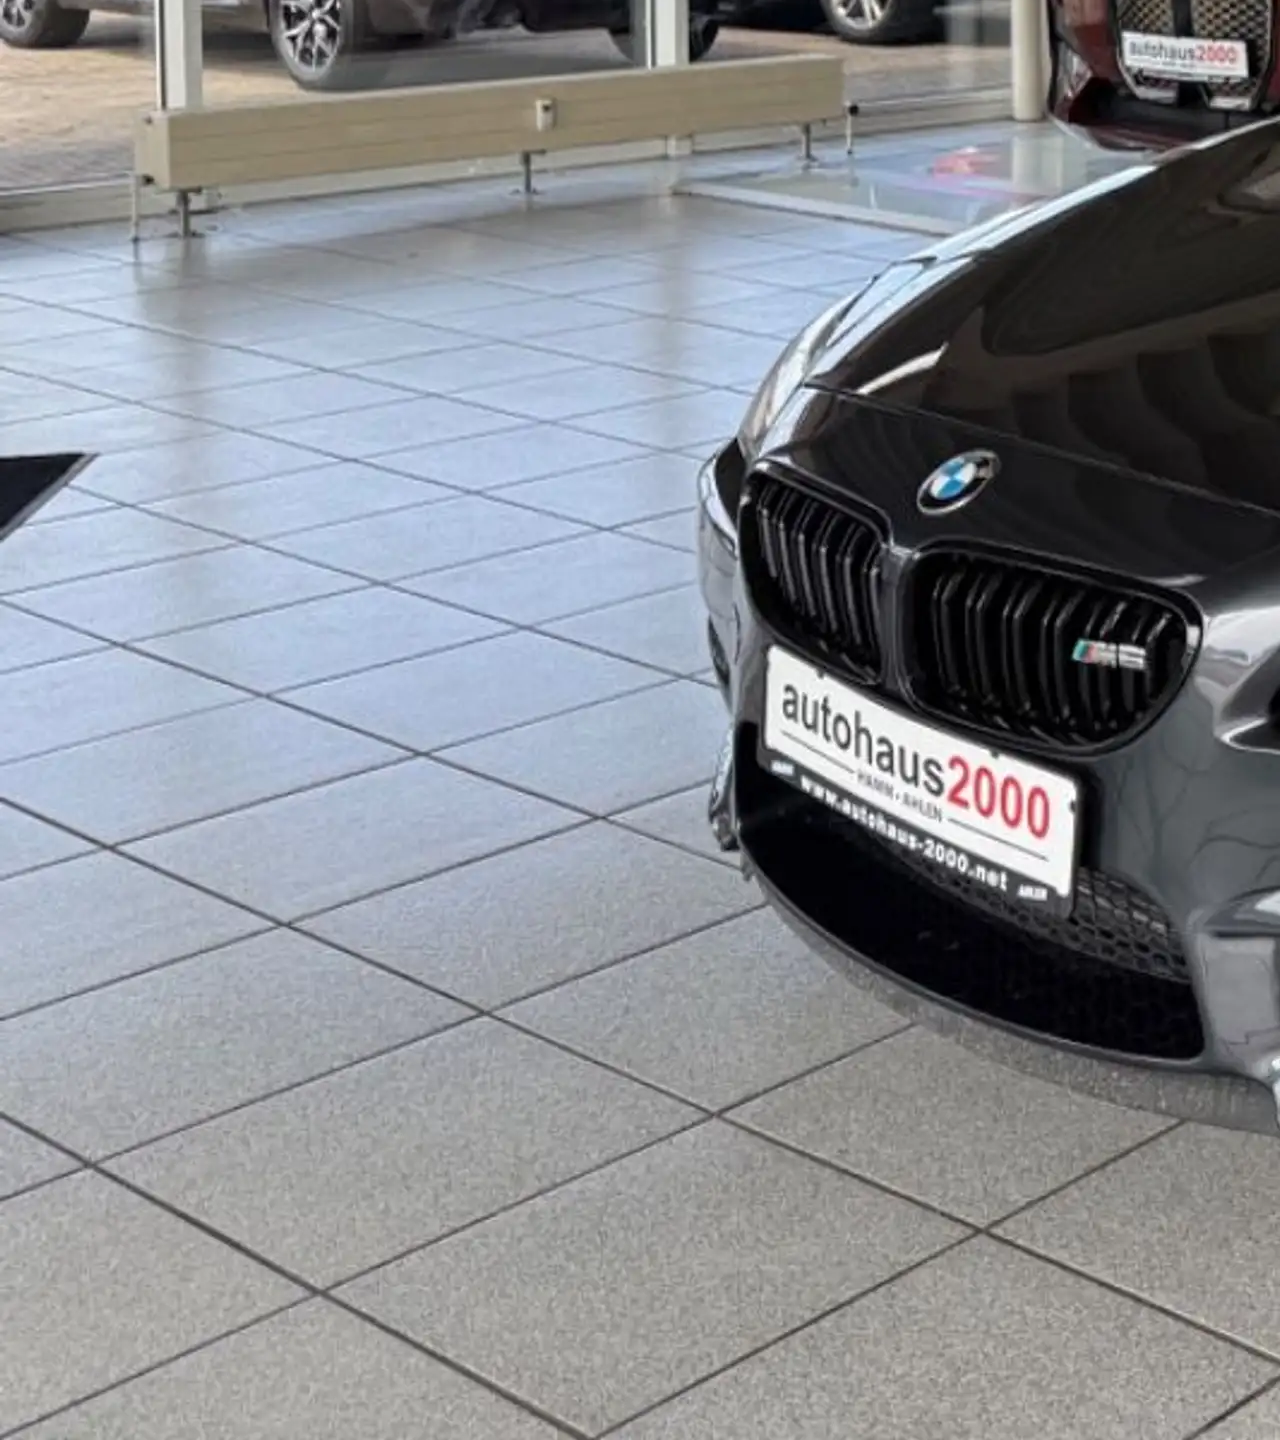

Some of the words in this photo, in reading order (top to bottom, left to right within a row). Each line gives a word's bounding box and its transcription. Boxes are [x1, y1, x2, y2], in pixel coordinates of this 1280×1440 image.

[1128, 39, 1238, 65] autohaus2000
[781, 682, 1051, 840] autohaus2000
[799, 773, 1008, 892] www.autohaus-2000.net
